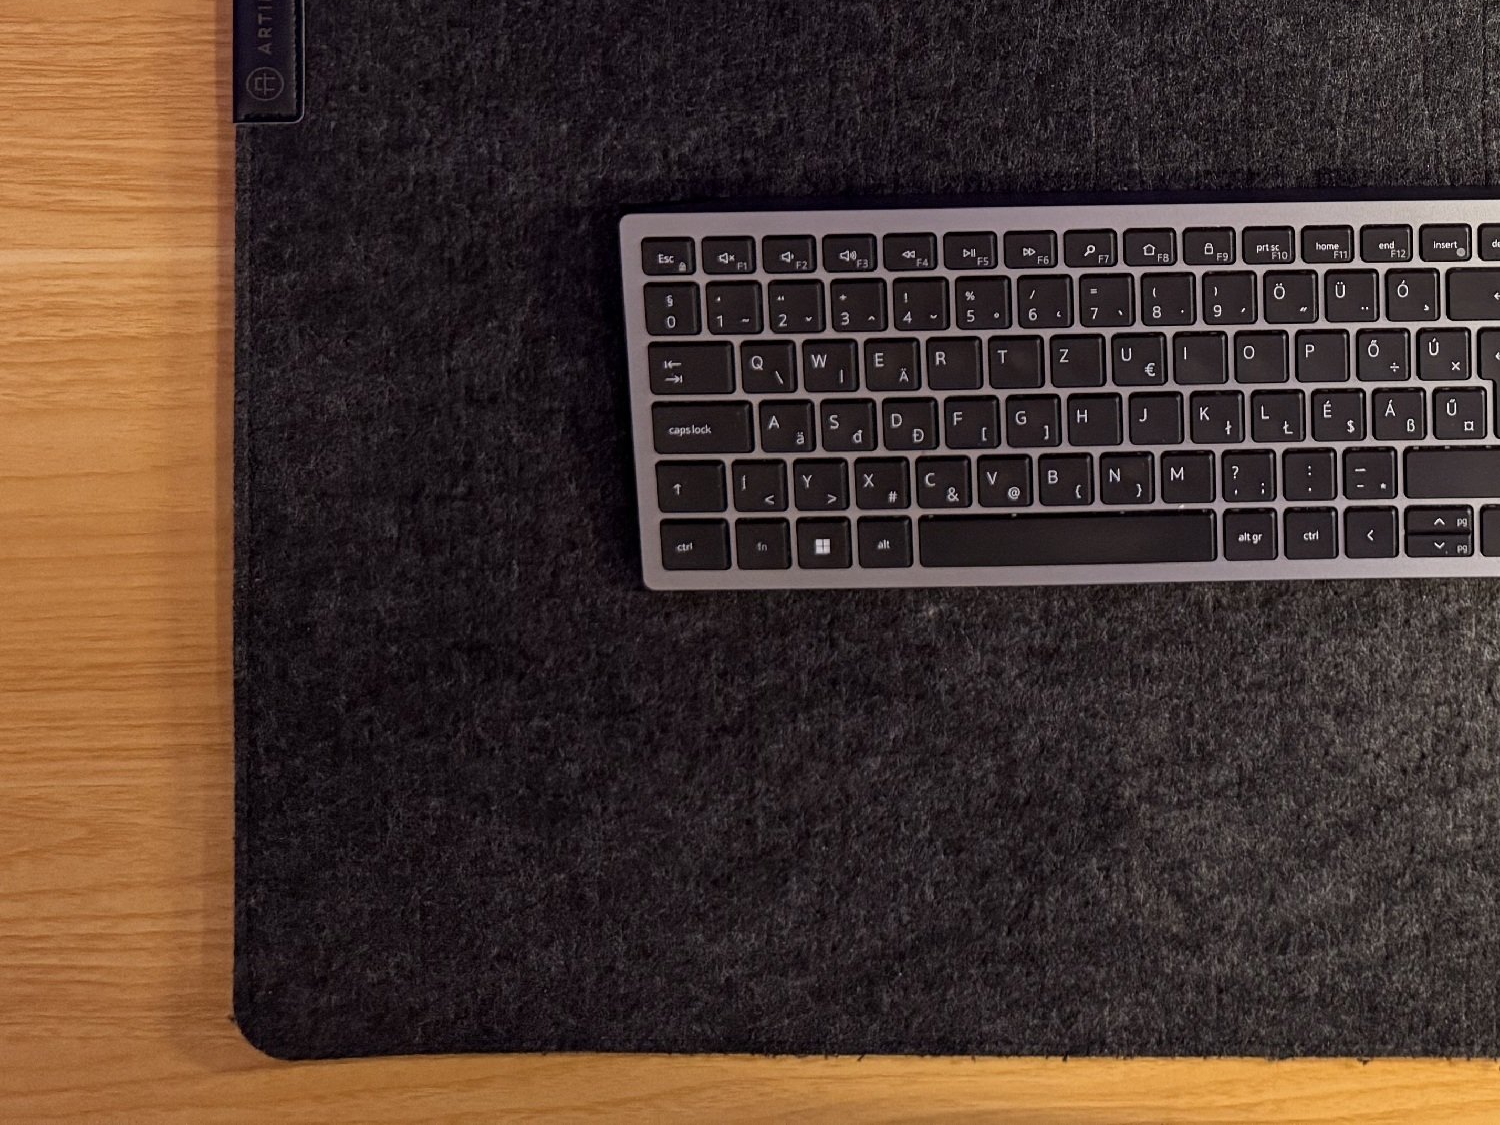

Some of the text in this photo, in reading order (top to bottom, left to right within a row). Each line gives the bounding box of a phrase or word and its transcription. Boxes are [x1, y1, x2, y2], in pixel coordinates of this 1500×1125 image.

[1256, 244, 1281, 255] prt sc
[1315, 242, 1341, 251] home
[1378, 240, 1396, 250] end
[1432, 240, 1458, 250] insert
[657, 253, 675, 264] Esc
[1037, 255, 1050, 265] F6
[1098, 254, 1110, 264] F7
[1157, 253, 1170, 263] F8
[1216, 252, 1229, 262] F9
[1271, 250, 1289, 260] F10
[1333, 249, 1348, 259] F11
[1390, 248, 1406, 259] F12
[736, 261, 748, 271] F1
[795, 260, 808, 270] F2
[856, 258, 869, 269] F3
[916, 257, 929, 268] F4
[976, 256, 989, 266] F5
[1273, 282, 1286, 300] Ö
[1335, 281, 1346, 299] Ü
[1397, 279, 1409, 298] Ó
[902, 310, 913, 324] 4
[966, 309, 975, 323] 5
[1028, 307, 1038, 321] 6
[1090, 307, 1099, 320] 7
[1152, 305, 1162, 319] 8
[1213, 304, 1222, 318] 9
[666, 315, 676, 329] 0
[778, 313, 788, 328] 2
[840, 311, 850, 326] 3
[1243, 345, 1255, 360] O
[1305, 344, 1315, 358] P
[1428, 337, 1440, 356] Ú
[810, 354, 827, 369] W
[874, 352, 885, 368] E
[935, 351, 947, 366] R
[997, 349, 1008, 364] T
[1059, 348, 1069, 363] Z
[1121, 347, 1132, 362] U
[751, 355, 764, 371] Q
[899, 367, 909, 383] Ä
[1138, 407, 1148, 423] J
[1199, 406, 1210, 421] K
[1260, 405, 1270, 420] L
[1323, 400, 1332, 419] É
[1384, 399, 1396, 417] Á
[768, 415, 780, 430] A
[829, 414, 840, 430] S
[891, 413, 903, 429] D
[953, 411, 963, 426] F
[1015, 410, 1027, 426] G
[1076, 409, 1088, 424] H
[668, 423, 712, 437] caps lock
[1282, 420, 1294, 435] Ł
[863, 473, 875, 488] X
[924, 472, 936, 487] C
[986, 471, 998, 485] V
[1047, 469, 1059, 485] B
[1109, 467, 1121, 483] N
[1170, 466, 1184, 481] M
[802, 474, 813, 489] Y
[1456, 518, 1468, 528] pg
[1237, 532, 1263, 545] alt gr
[1303, 530, 1319, 541] ctrl
[676, 542, 693, 552] ctrl
[877, 539, 890, 550] alt
[1456, 544, 1468, 554] pg
